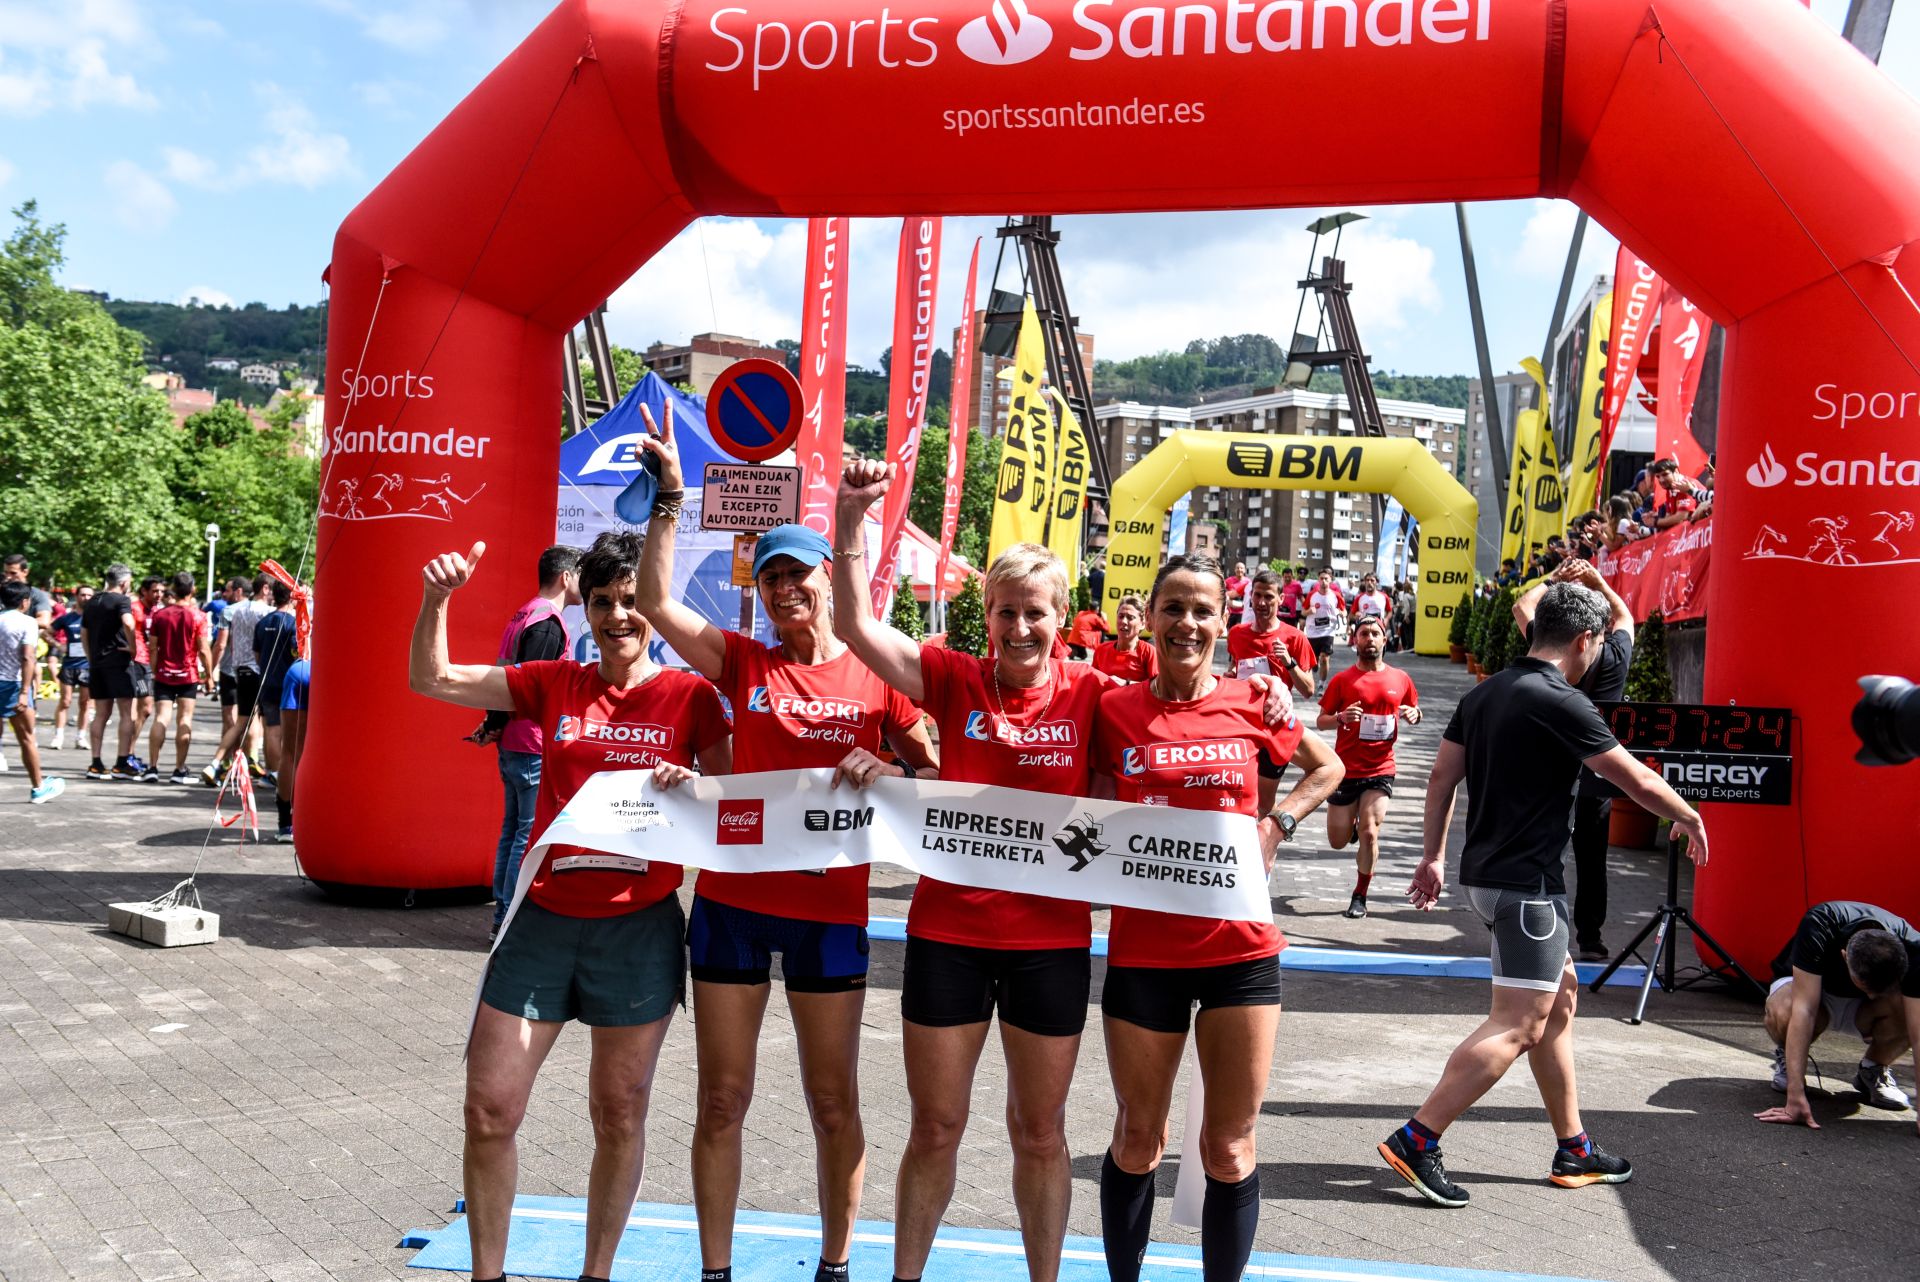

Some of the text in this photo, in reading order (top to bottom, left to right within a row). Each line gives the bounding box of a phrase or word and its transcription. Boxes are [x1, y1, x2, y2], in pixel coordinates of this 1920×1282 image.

[706, 7, 939, 91] Sports
[943, 98, 1205, 136] sportssantander.es
[340, 368, 434, 406] Sports
[1812, 383, 1920, 429] Spor
[332, 424, 491, 459] Santander
[1062, 430, 1085, 485] BM
[1278, 445, 1363, 481] BM
[711, 469, 791, 482] BAIMENDUAK
[755, 485, 781, 495] EZIK
[722, 501, 778, 513] EXCEPTO
[707, 514, 792, 526] AUTORIZADOS
[1129, 521, 1154, 535] BM
[1444, 536, 1469, 550] BM
[1125, 554, 1151, 568] BM
[1442, 571, 1467, 584] BM
[777, 698, 859, 722] EROSKI
[584, 723, 666, 745] EROSKI
[797, 726, 855, 746] zurekin
[996, 722, 1071, 744] EROSKI
[603, 751, 662, 766] zurekin
[1017, 750, 1073, 767] zurekin
[1155, 743, 1243, 765] EROSKI
[1183, 769, 1244, 788] zurekin
[1219, 797, 1236, 807] 310
[1712, 785, 1761, 799] Experts
[622, 800, 655, 808] Bizkaia
[833, 807, 875, 831] BM
[924, 808, 1044, 841] ENPRESEN
[921, 835, 1045, 865] LASTERKETA
[1128, 834, 1238, 865] CARRERA
[1122, 860, 1236, 889] DEMPRESAS
